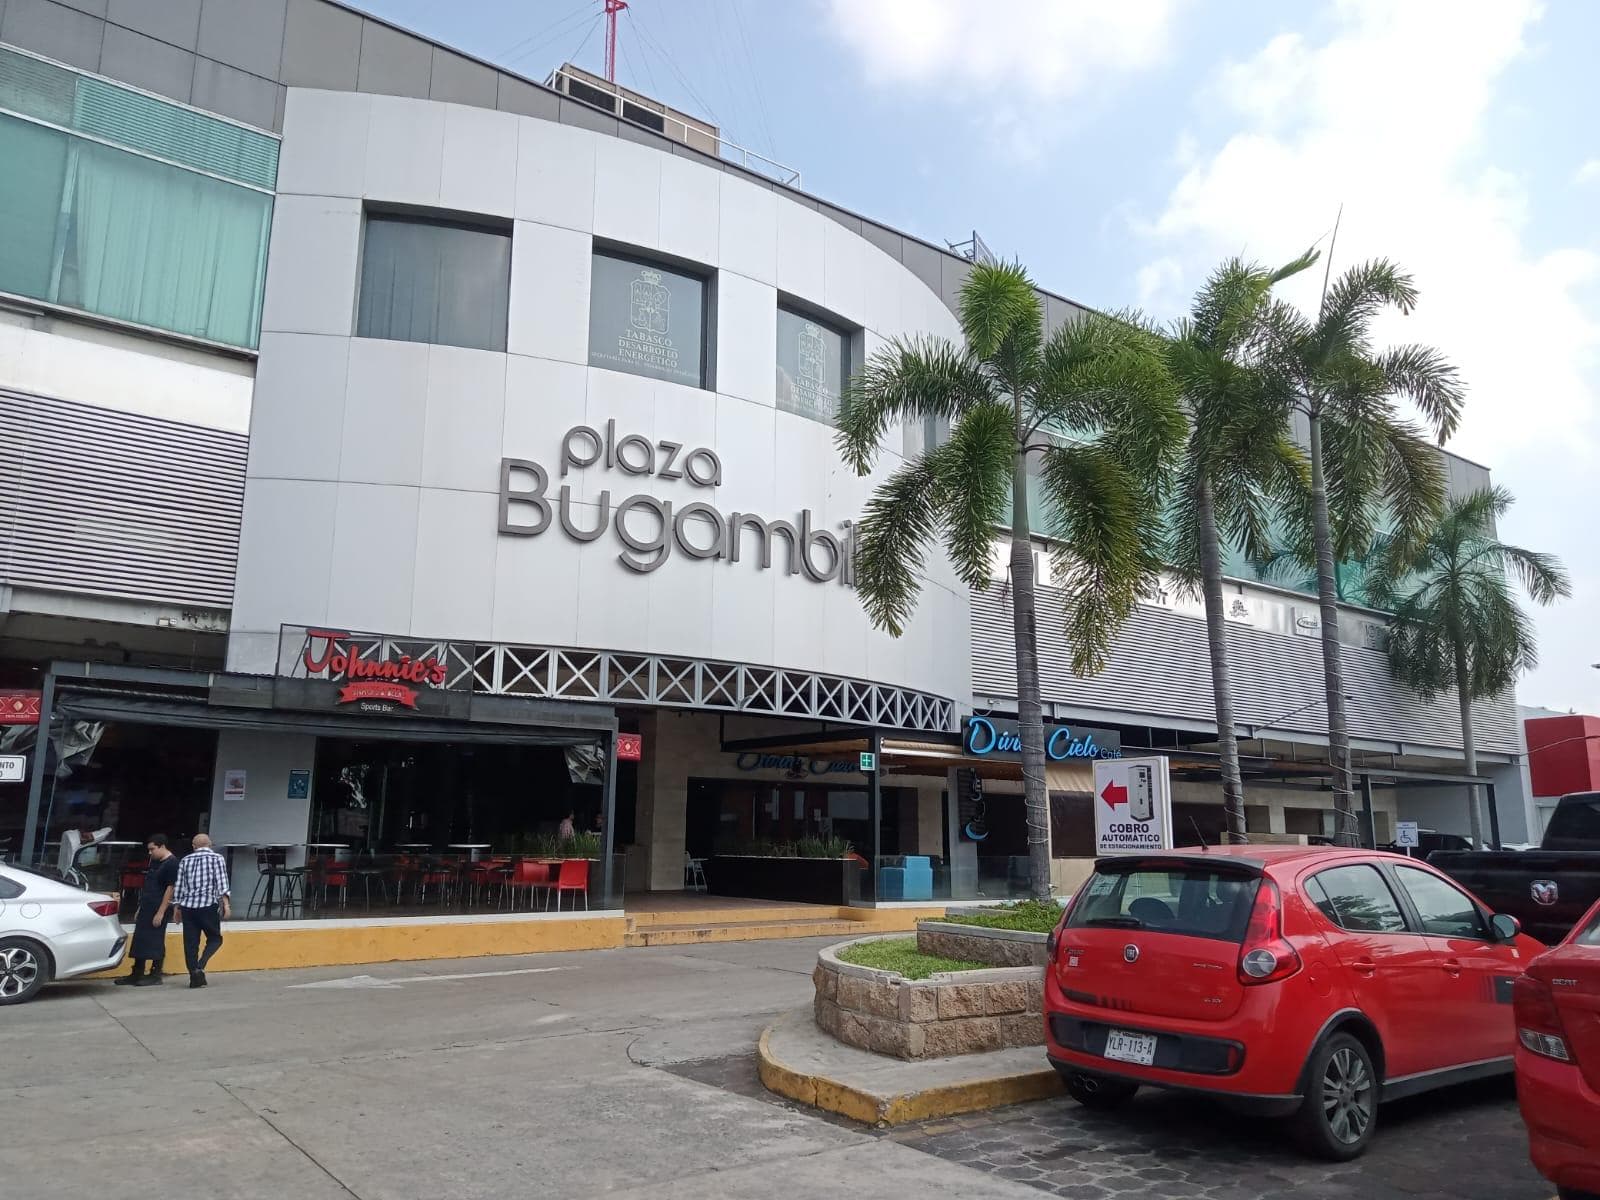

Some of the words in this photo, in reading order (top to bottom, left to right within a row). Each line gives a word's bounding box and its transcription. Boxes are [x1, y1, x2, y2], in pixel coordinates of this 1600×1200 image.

[625, 329, 673, 347] TABASCO
[618, 339, 679, 359] DESARROLLO
[560, 418, 723, 487] plaza
[303, 628, 448, 683] Johnnie's
[360, 702, 382, 712] Sports
[382, 704, 395, 712] Bar
[1048, 727, 1101, 760] Cielo
[1109, 823, 1150, 833] COBRO
[1108, 1036, 1153, 1056] YLR-113-A
